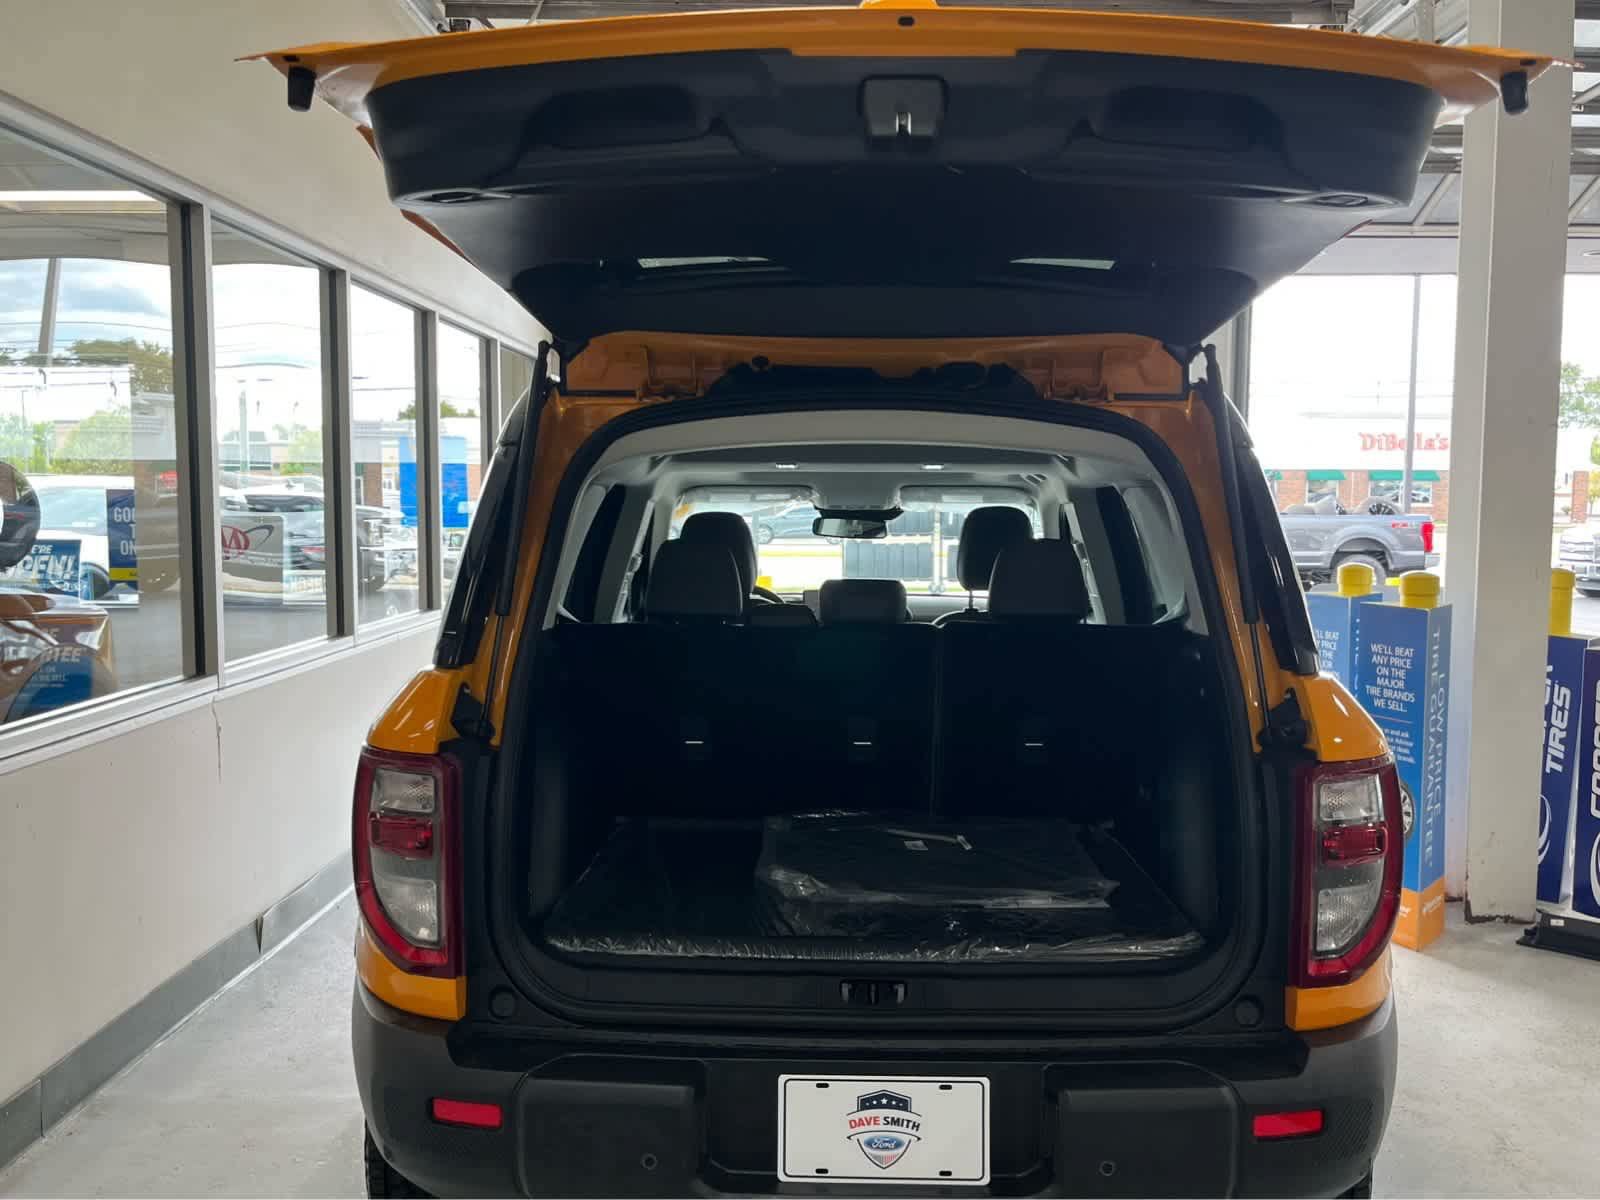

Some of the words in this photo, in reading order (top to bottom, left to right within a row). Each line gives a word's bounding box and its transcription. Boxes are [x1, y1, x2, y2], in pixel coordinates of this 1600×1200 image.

[1359, 432, 1448, 450] DiBela's
[1371, 643, 1393, 656] WE'LL
[1394, 647, 1415, 657] BEAT
[1430, 629, 1441, 685] TIRE
[1371, 655, 1388, 665] ANY
[1389, 657, 1412, 669] PRICE
[1376, 667, 1390, 676] ON
[1390, 668, 1407, 679] THE
[1376, 677, 1405, 689] MAJOR
[1365, 684, 1382, 697] TIRE
[1382, 687, 1416, 702] BRANDS
[1373, 698, 1387, 709] WE
[1387, 700, 1408, 712] SELL.
[1436, 672, 1447, 732] LOW
[1545, 683, 1572, 774] TIRES
[1433, 743, 1443, 817] PRICE
[848, 1116, 881, 1129] DAVE
[882, 1116, 921, 1132] SMITH
[871, 1138, 897, 1150] Ford
